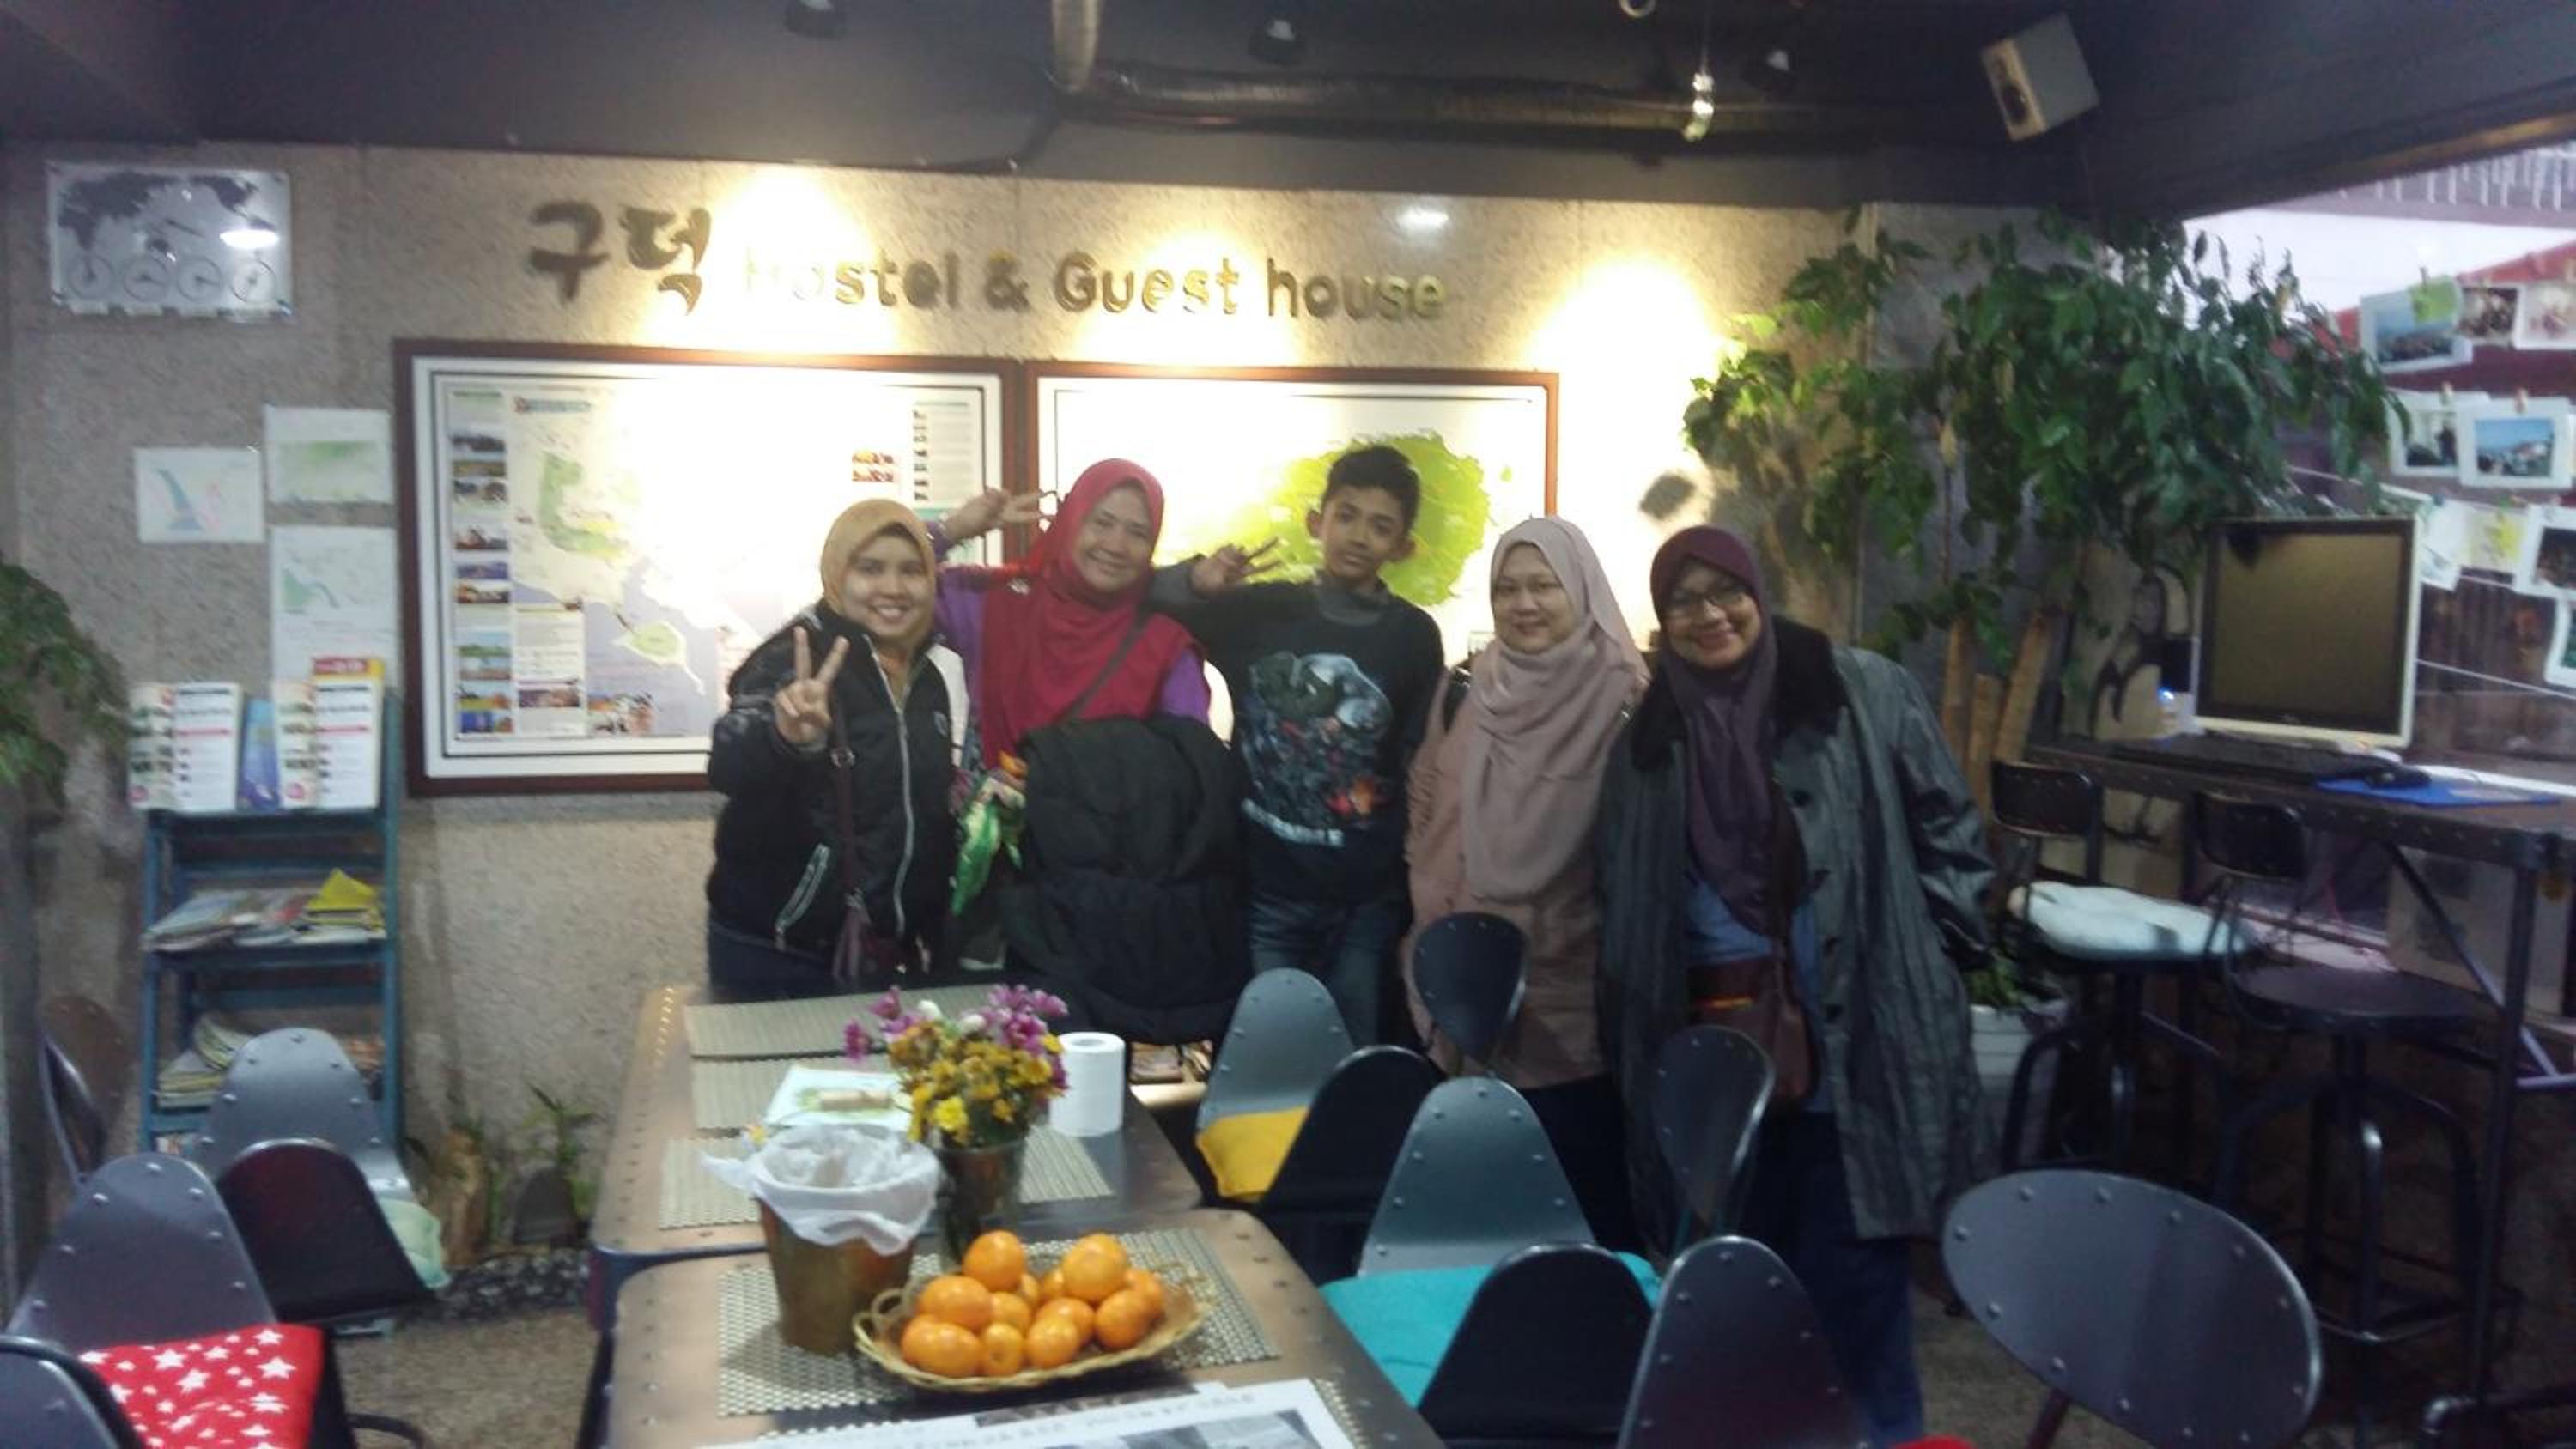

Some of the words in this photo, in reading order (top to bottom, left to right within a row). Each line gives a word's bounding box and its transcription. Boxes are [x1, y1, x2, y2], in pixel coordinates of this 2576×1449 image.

[984, 250, 1031, 309] &
[1053, 252, 1240, 315] Guest
[1267, 257, 1446, 319] house
